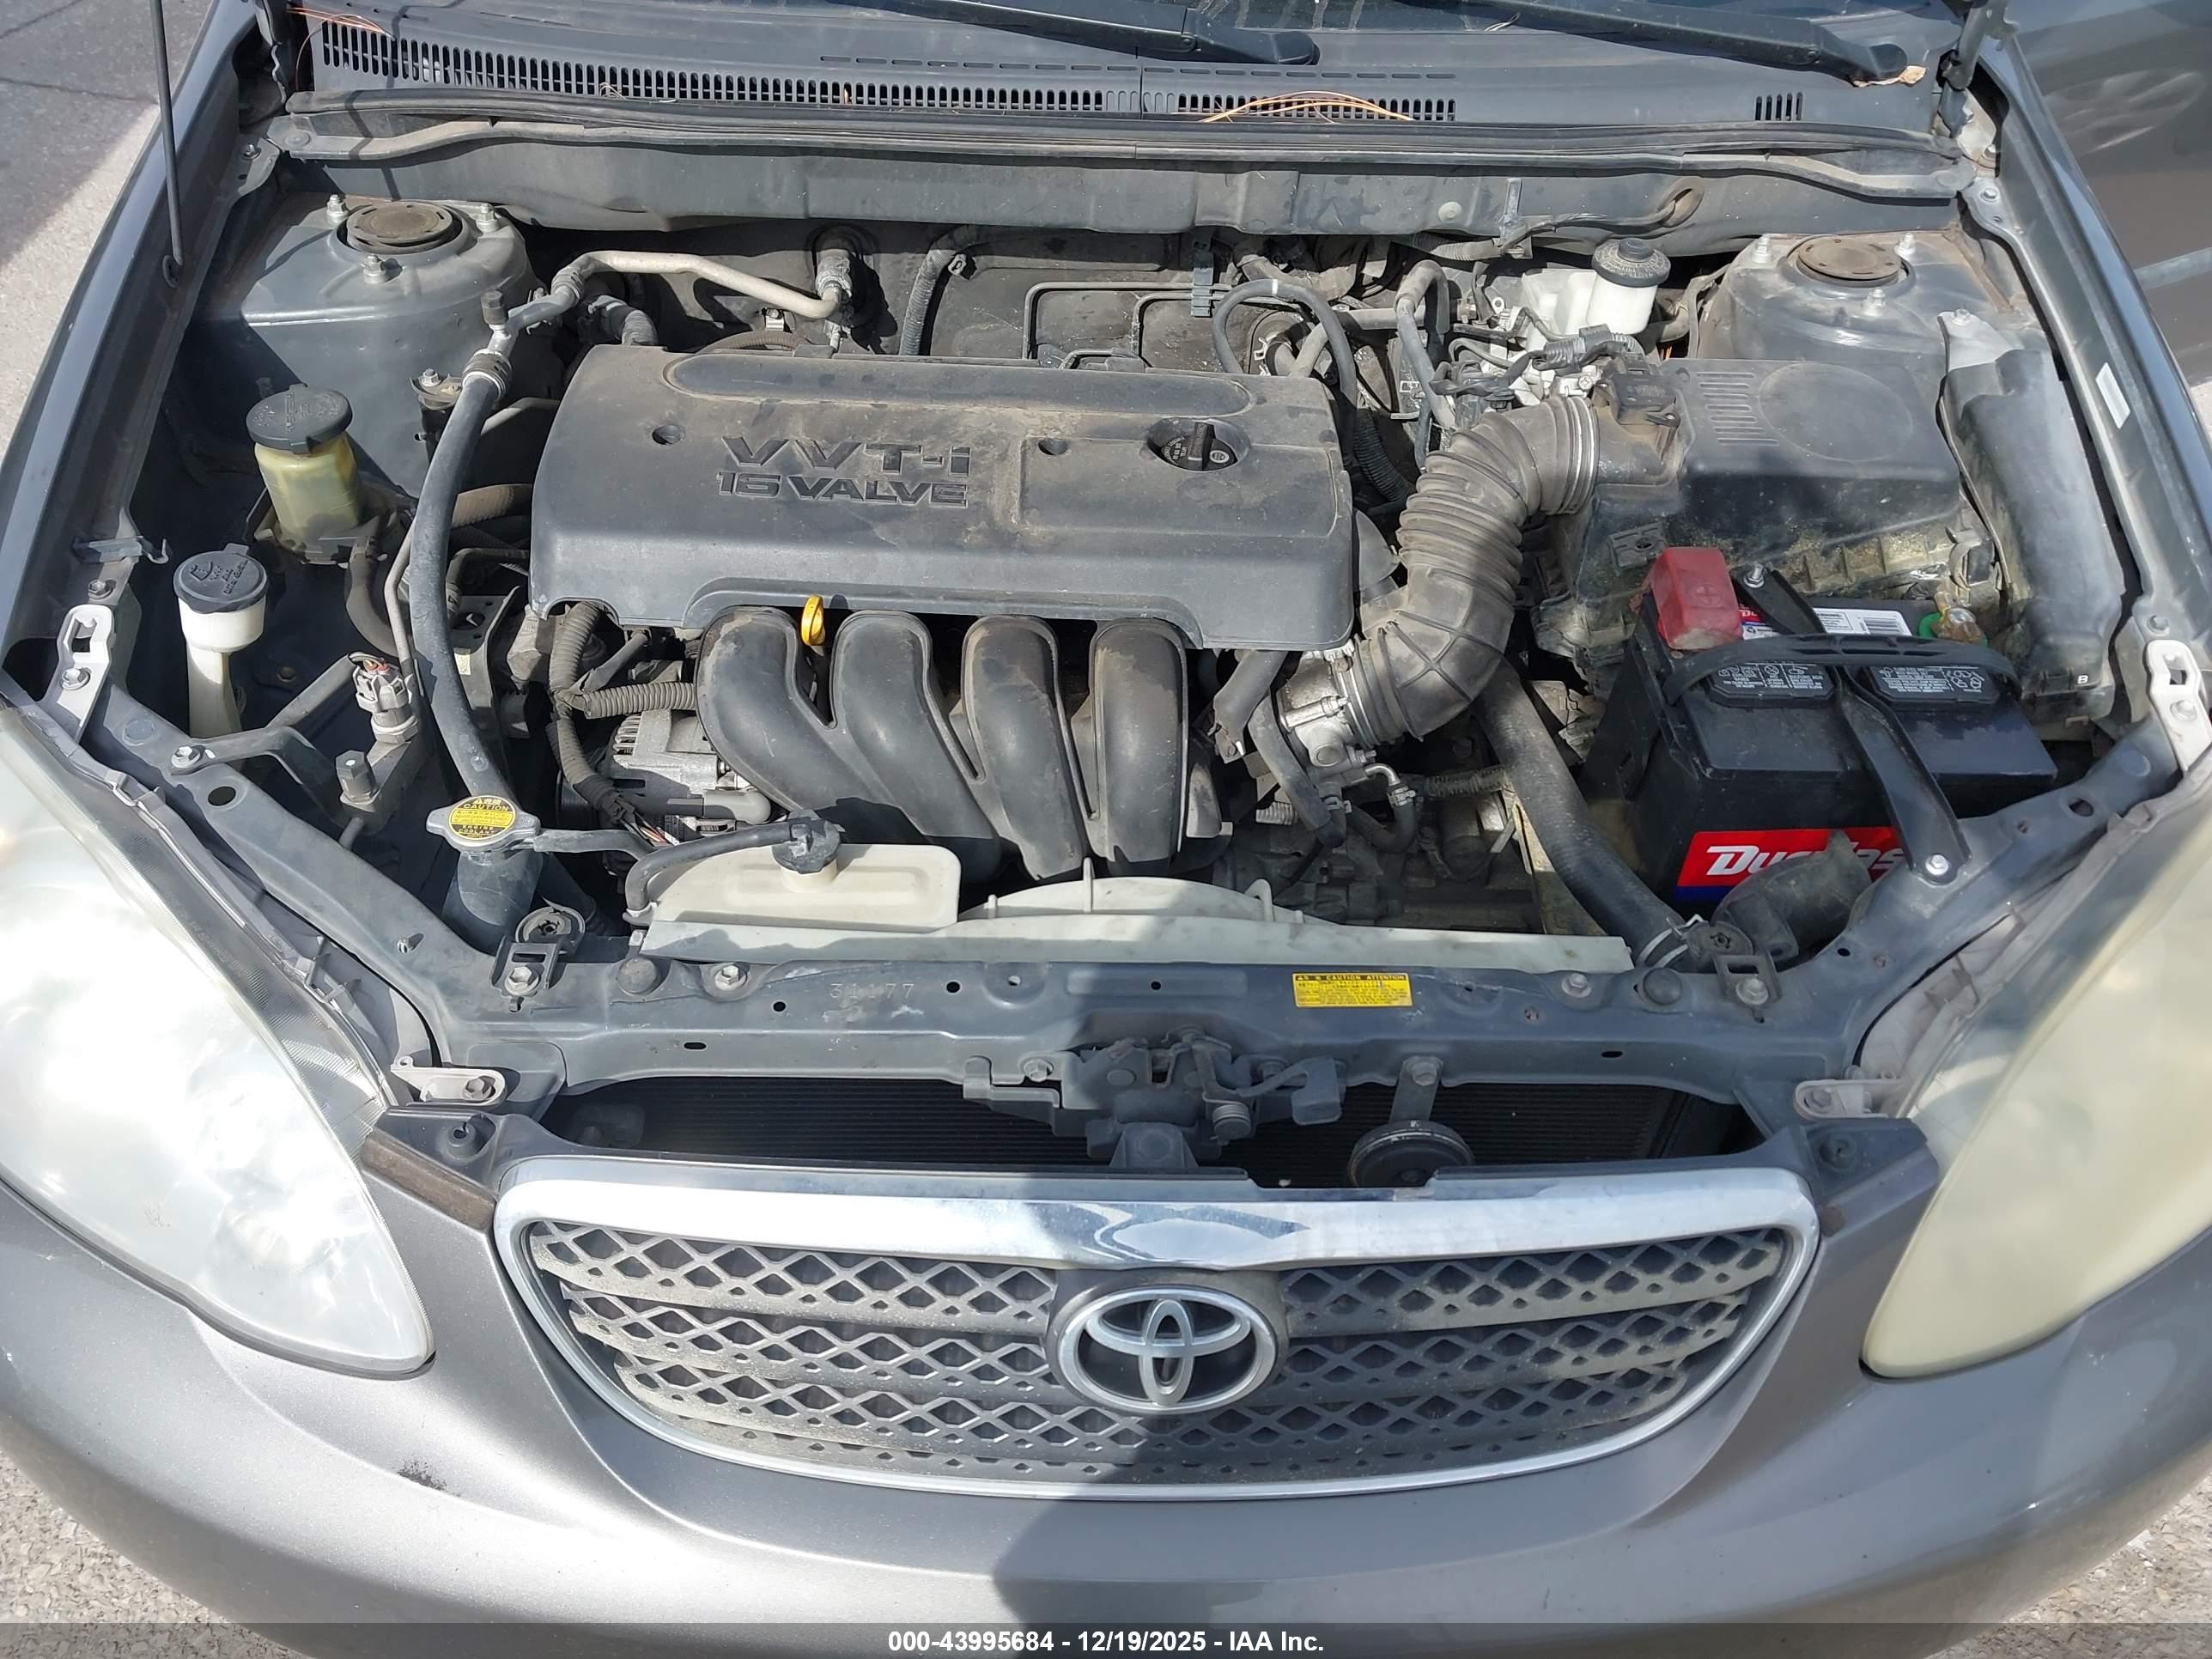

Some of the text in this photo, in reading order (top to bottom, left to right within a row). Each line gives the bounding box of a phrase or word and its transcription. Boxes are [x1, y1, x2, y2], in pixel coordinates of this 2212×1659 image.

[722, 435, 970, 477] VVT-i
[716, 471, 969, 508] 16 VALVE
[464, 803, 509, 811] CAUTION
[830, 982, 915, 999] 31177
